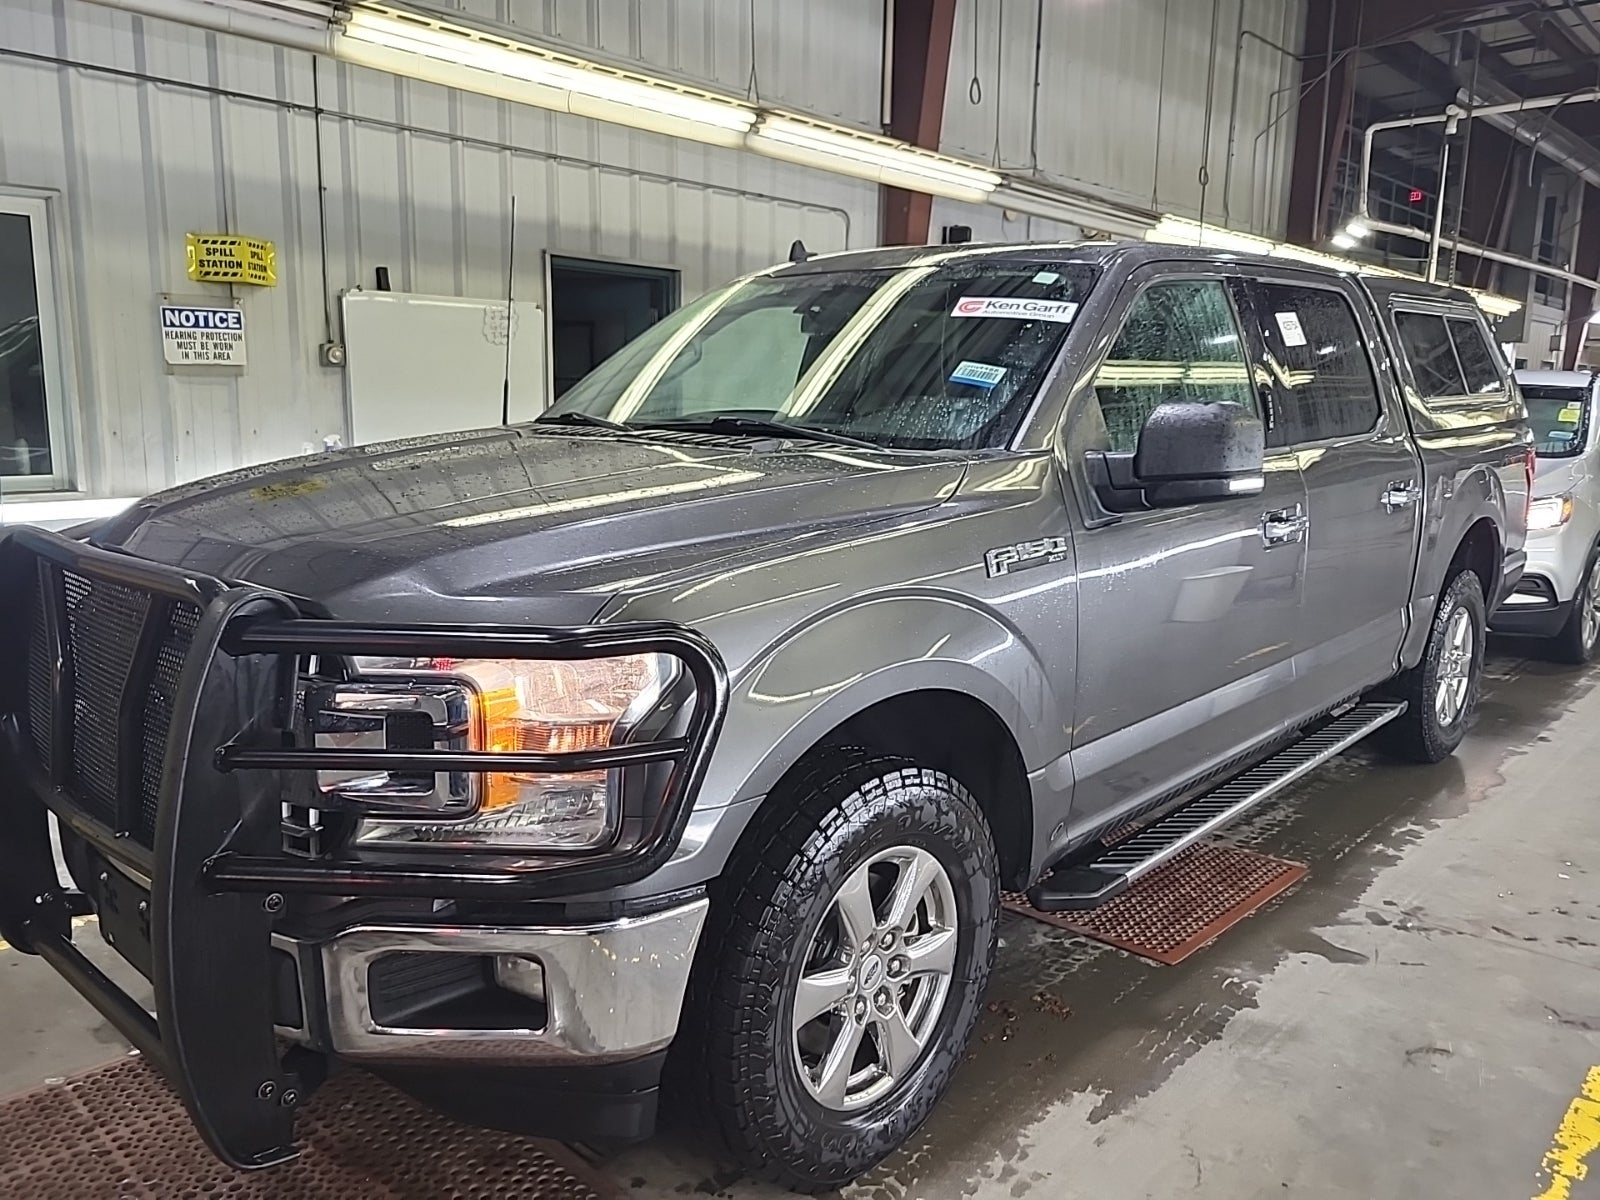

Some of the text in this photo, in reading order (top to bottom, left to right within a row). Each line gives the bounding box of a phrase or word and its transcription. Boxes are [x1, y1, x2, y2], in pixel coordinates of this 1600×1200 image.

[205, 247, 235, 257] SPILL
[250, 250, 264, 261] SPILL
[198, 259, 243, 269] STATION
[247, 261, 267, 273] STATION
[985, 300, 1071, 313] Ken Garff
[164, 309, 241, 328] NOTICE
[164, 331, 243, 342] HEARING PROTECTION
[176, 341, 234, 351] MUST BE WORN
[181, 351, 232, 361] IN THIS AREA
[1048, 552, 1065, 562] XLT
